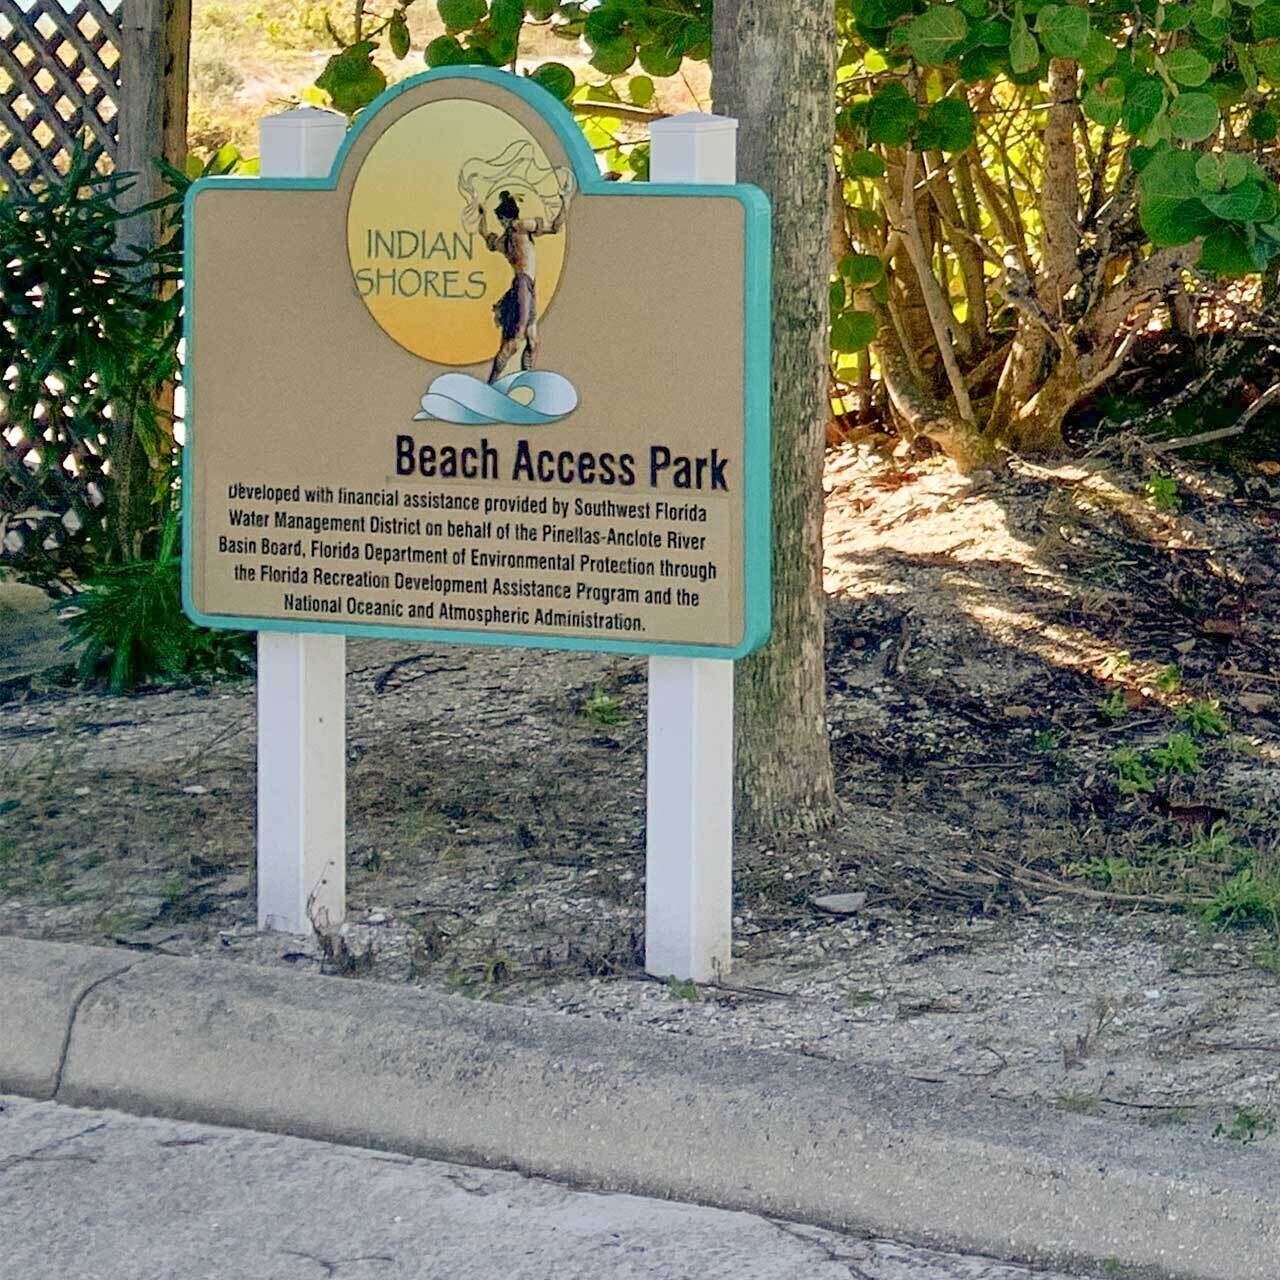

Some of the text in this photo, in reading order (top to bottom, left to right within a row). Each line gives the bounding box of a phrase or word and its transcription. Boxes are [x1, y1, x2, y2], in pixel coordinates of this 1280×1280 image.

[367, 229, 474, 261] INDIAN
[354, 267, 487, 299] SHORES
[395, 435, 729, 492] Beach Access Park
[229, 483, 707, 522] Developed with financial assistance provided by Southwest Florida
[229, 509, 706, 550] Water Management District on behalf of the Pinellas-Anclote River
[218, 536, 716, 582] Basin Board, Florida Department of Environmental Protection through
[234, 564, 699, 607] the Florida Recreation Development Assistance Program and the
[284, 594, 646, 632] National Oceanic and Atmospheric Administration.
